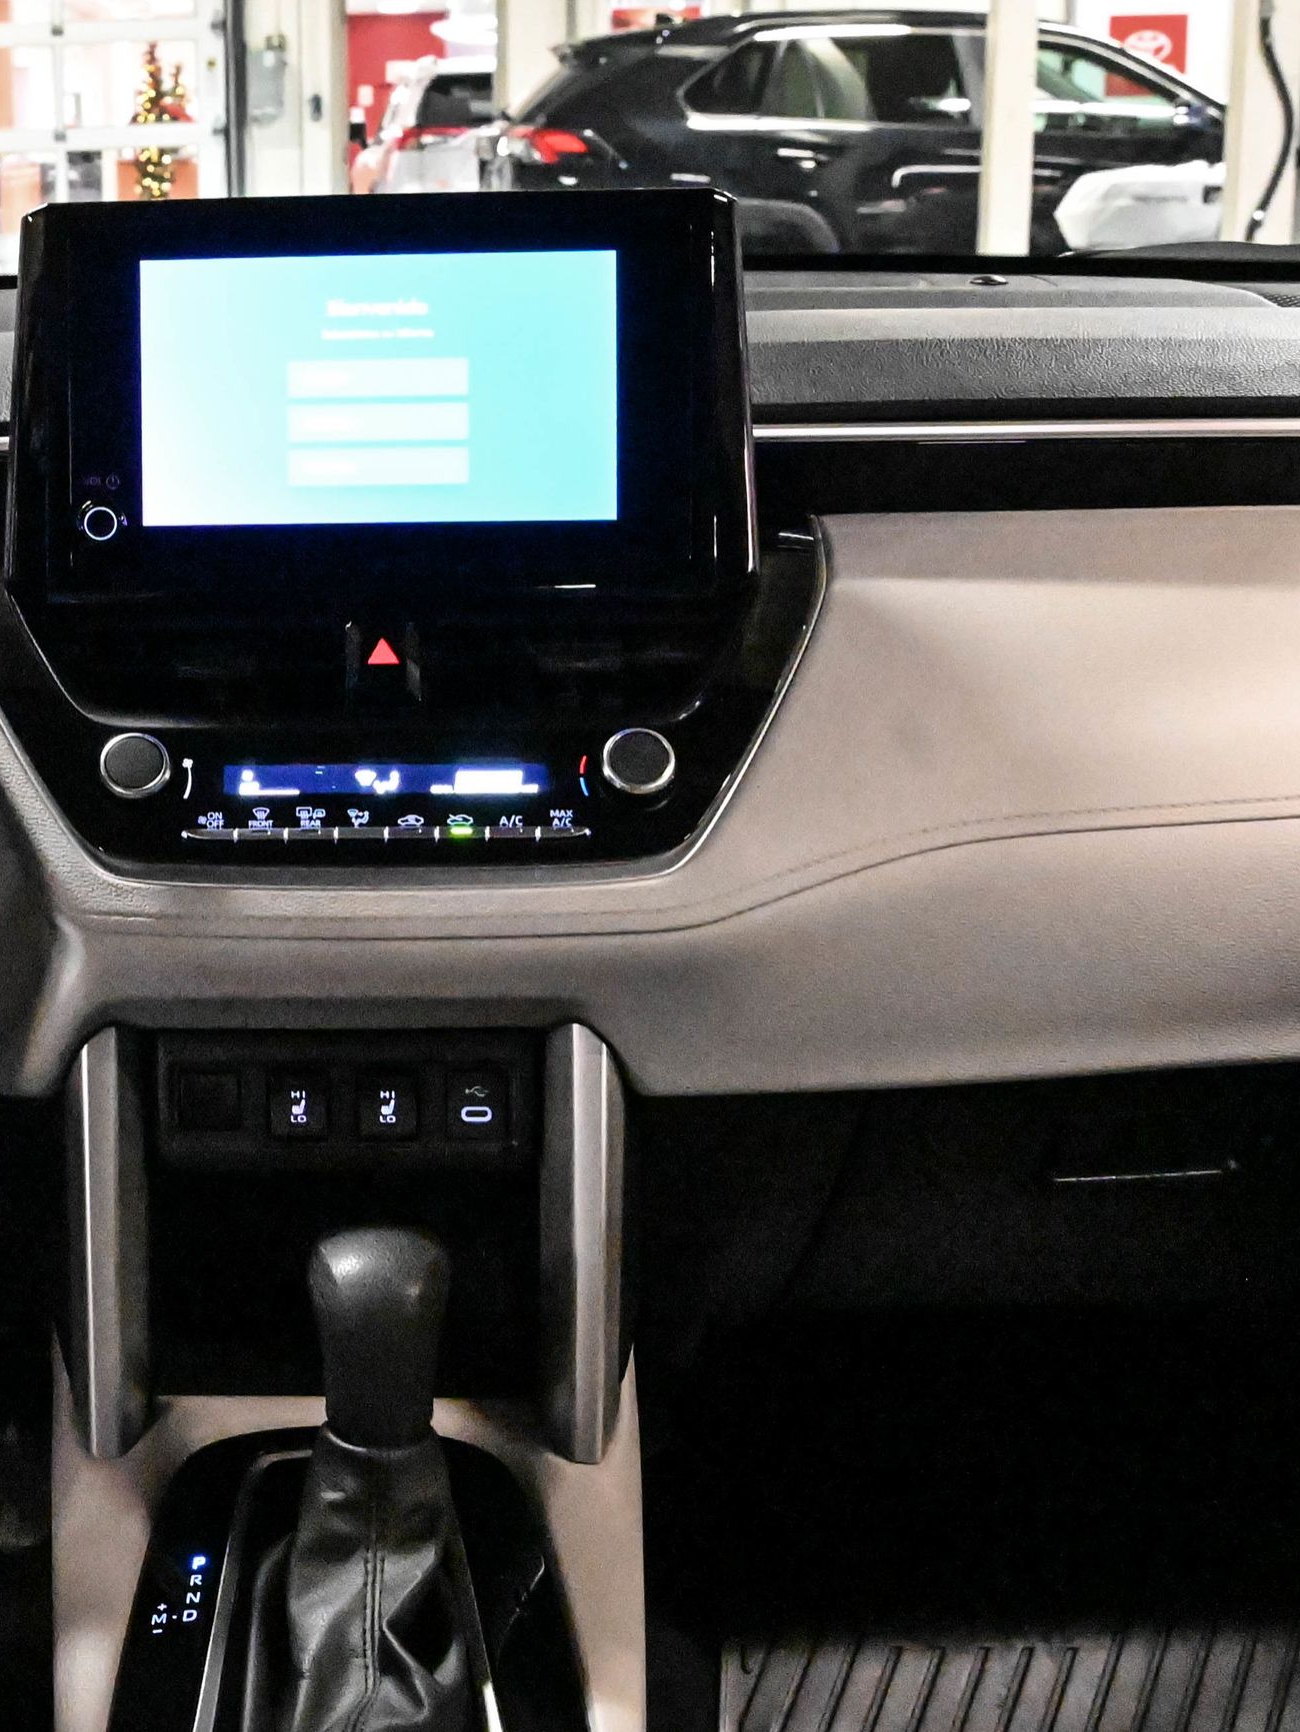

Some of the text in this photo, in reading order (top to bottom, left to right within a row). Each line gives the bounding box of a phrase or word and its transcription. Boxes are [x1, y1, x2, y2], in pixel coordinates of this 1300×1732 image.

[207, 811, 223, 820] ON
[550, 809, 573, 818] MAX
[206, 820, 225, 829] OFF
[248, 820, 274, 829] FRONT
[300, 820, 321, 828] REAR
[499, 815, 523, 827] A/C
[552, 817, 573, 827] A/C
[290, 1090, 306, 1099] HI
[379, 1090, 395, 1099] HI
[290, 1114, 307, 1123] LO
[379, 1114, 396, 1123] LO
[192, 1556, 206, 1570] P
[189, 1574, 203, 1587] R
[185, 1591, 201, 1605] N
[151, 1613, 167, 1626] M
[182, 1609, 198, 1623] D
